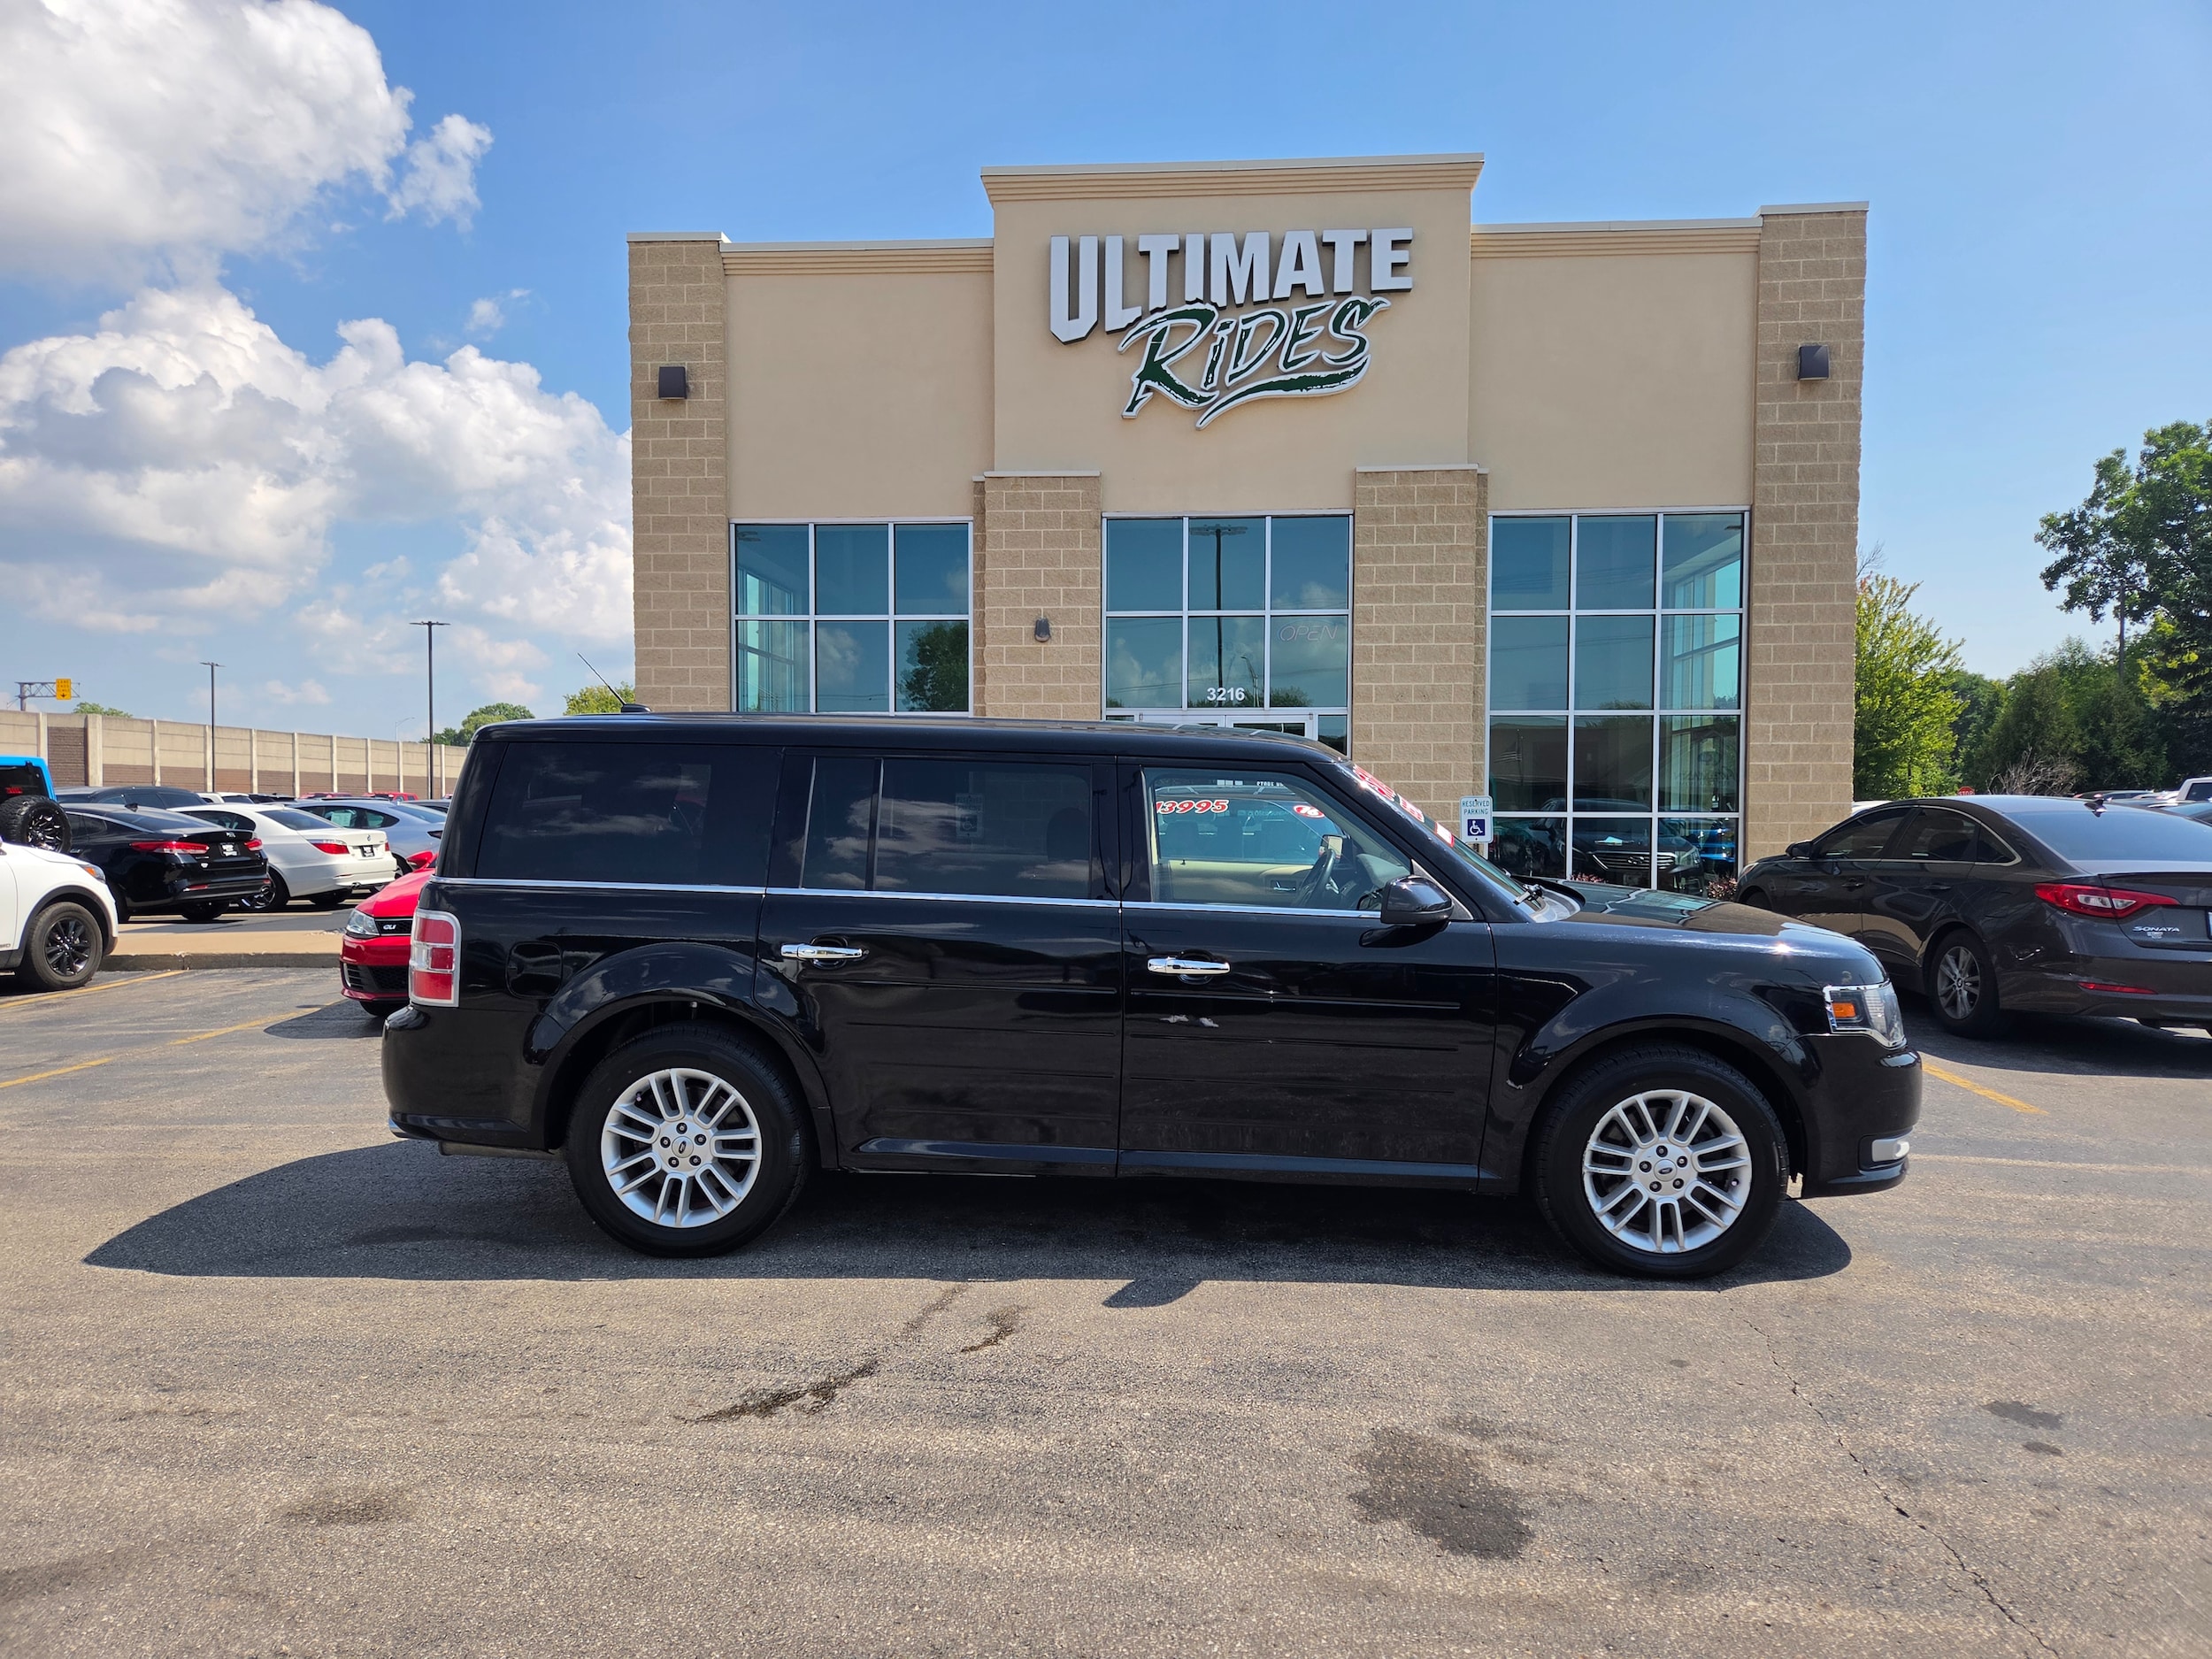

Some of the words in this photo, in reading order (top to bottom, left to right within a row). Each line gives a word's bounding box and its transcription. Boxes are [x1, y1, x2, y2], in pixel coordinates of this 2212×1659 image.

[1049, 227, 1413, 345] ULTIMATE
[1279, 625, 1339, 641] OPEN
[1206, 687, 1246, 702] 3216
[1156, 799, 1230, 814] 13995
[1299, 805, 1320, 817] 16
